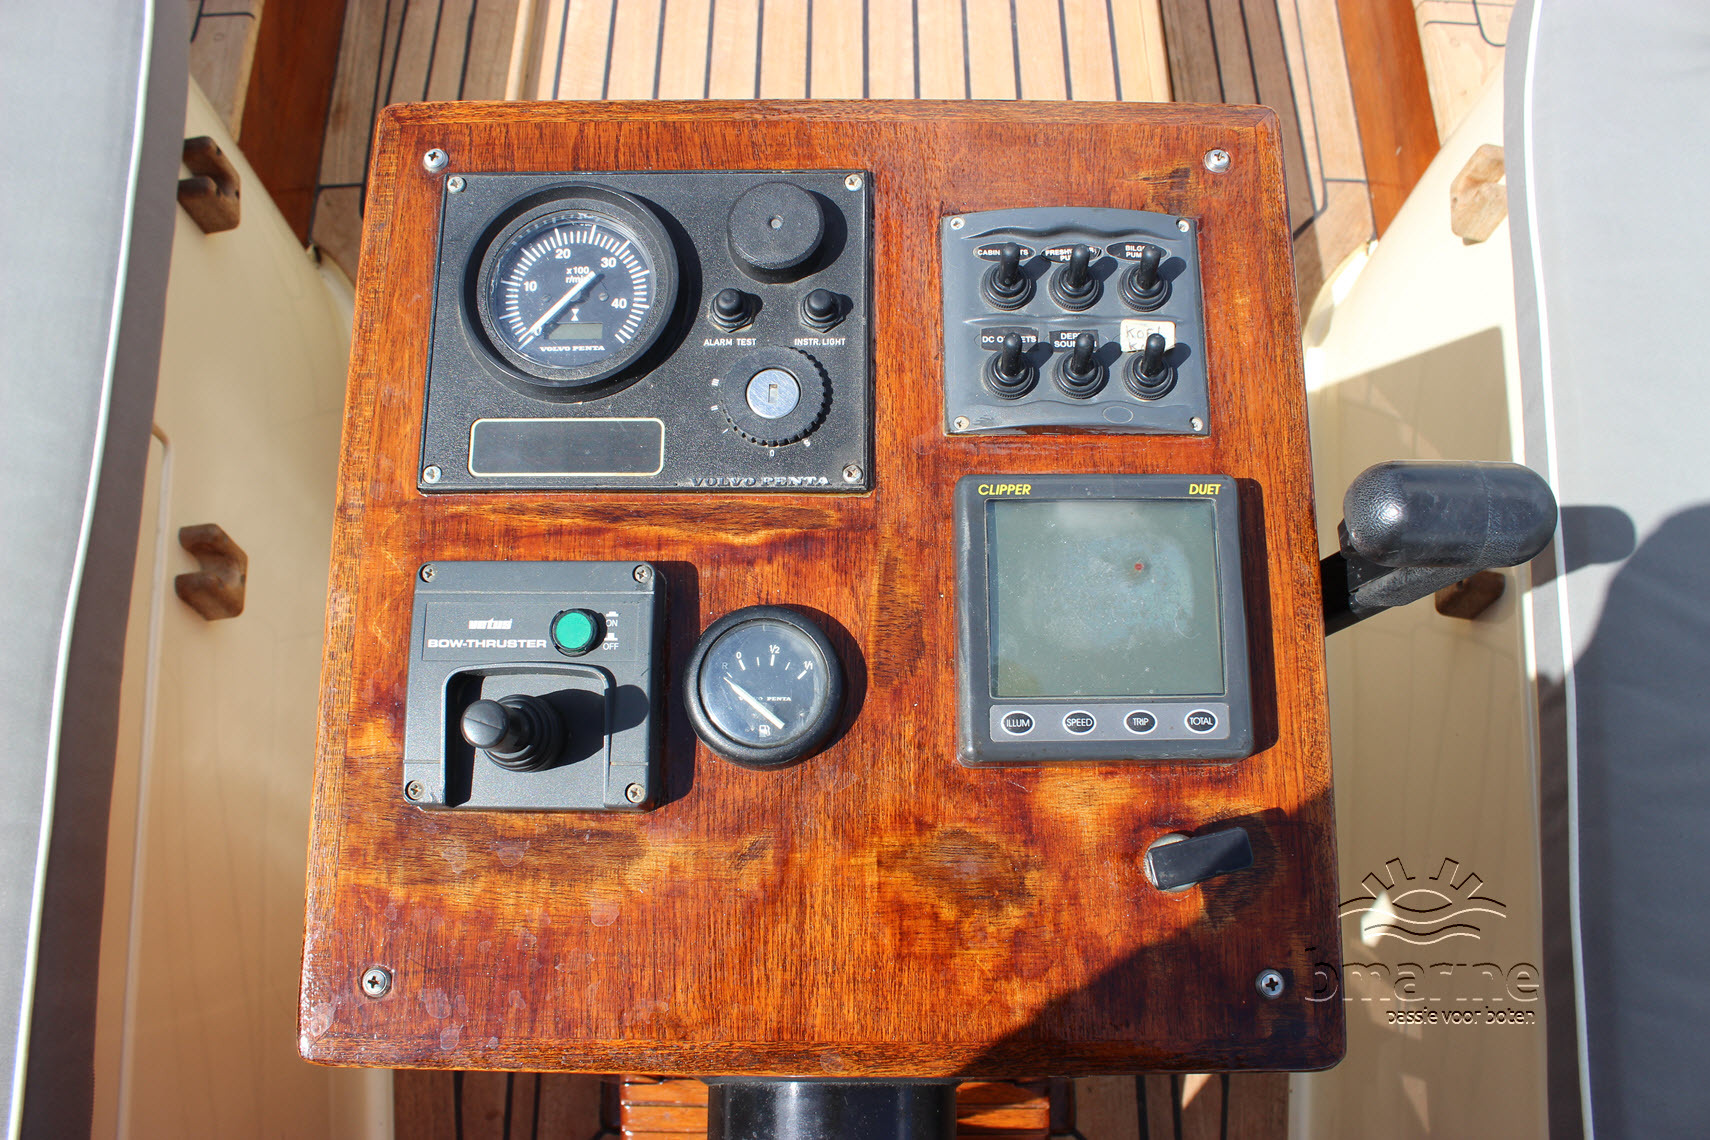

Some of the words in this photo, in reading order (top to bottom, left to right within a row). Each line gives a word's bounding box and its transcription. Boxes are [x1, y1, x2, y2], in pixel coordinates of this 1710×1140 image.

[1125, 244, 1146, 252] BILG
[555, 248, 571, 259] 20
[1125, 251, 1144, 259] PUM
[600, 257, 617, 268] 30
[566, 266, 590, 275] x100
[523, 281, 537, 292] 10
[611, 298, 627, 309] 40
[703, 338, 733, 347] ALARM
[736, 338, 757, 346] TEST
[982, 335, 995, 343] DC
[996, 335, 1037, 343] OETS
[690, 477, 757, 487] VOLVO
[760, 477, 833, 487] PENTA
[978, 484, 1031, 496] CLIPPER
[1189, 483, 1221, 495] DUET
[606, 619, 618, 628] ON
[427, 638, 547, 649] BOW-THRUSTER
[602, 642, 620, 650] OFF
[1006, 718, 1030, 728] ILLUM
[1066, 718, 1093, 727] SPEED
[1132, 717, 1149, 726] TRIP
[1189, 716, 1214, 726] TOTAL
